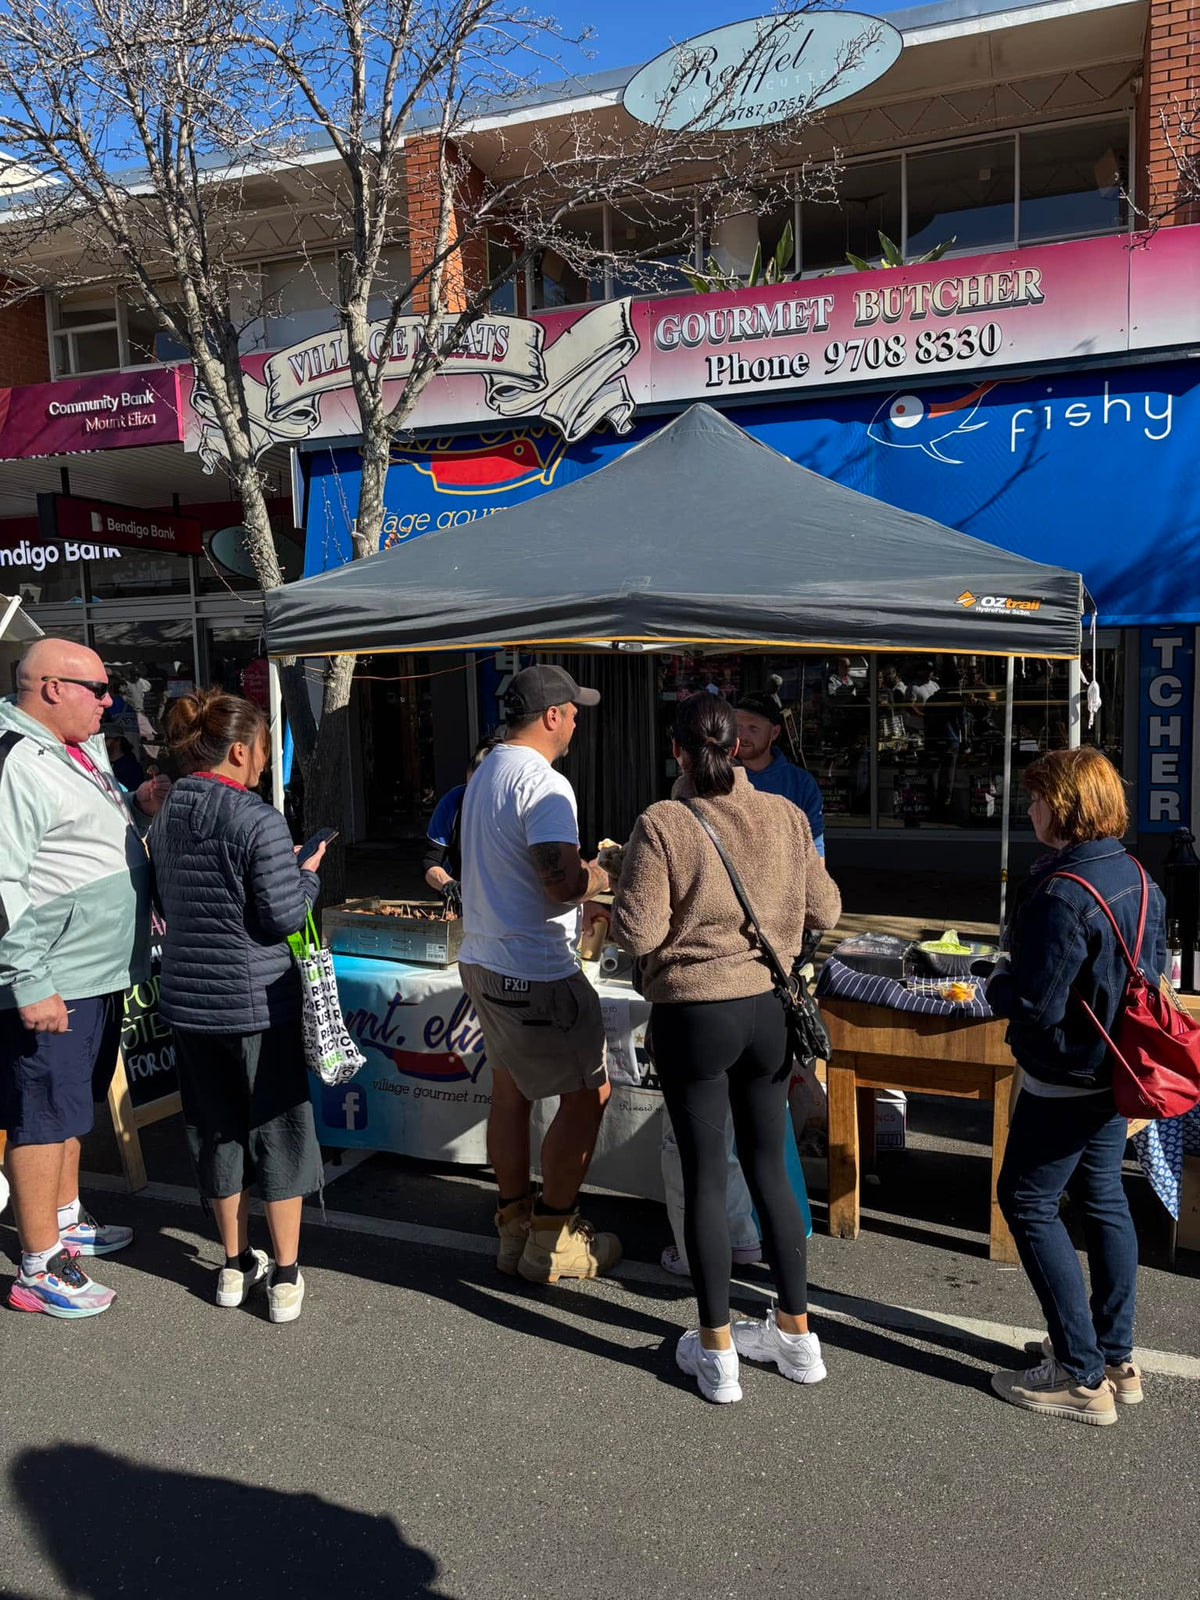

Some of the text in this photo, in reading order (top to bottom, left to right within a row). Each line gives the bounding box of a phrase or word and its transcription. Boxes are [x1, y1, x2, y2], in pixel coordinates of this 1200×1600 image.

[654, 266, 1046, 351] GOURMET BUTCHER
[289, 325, 408, 385] VILLGE
[705, 322, 1003, 387] Phone 9708 8330
[49, 389, 155, 416] Community Bank
[85, 411, 157, 432] Mount Eliza
[1010, 381, 1174, 453] fishy
[107, 517, 175, 540] Bendigo Bank
[980, 596, 1041, 611] OZtrail
[1148, 628, 1183, 821] TCHER
[504, 978, 529, 991] FXD
[424, 993, 485, 1051] eli
[372, 1079, 409, 1096] village
[414, 1084, 469, 1103] gourmet
